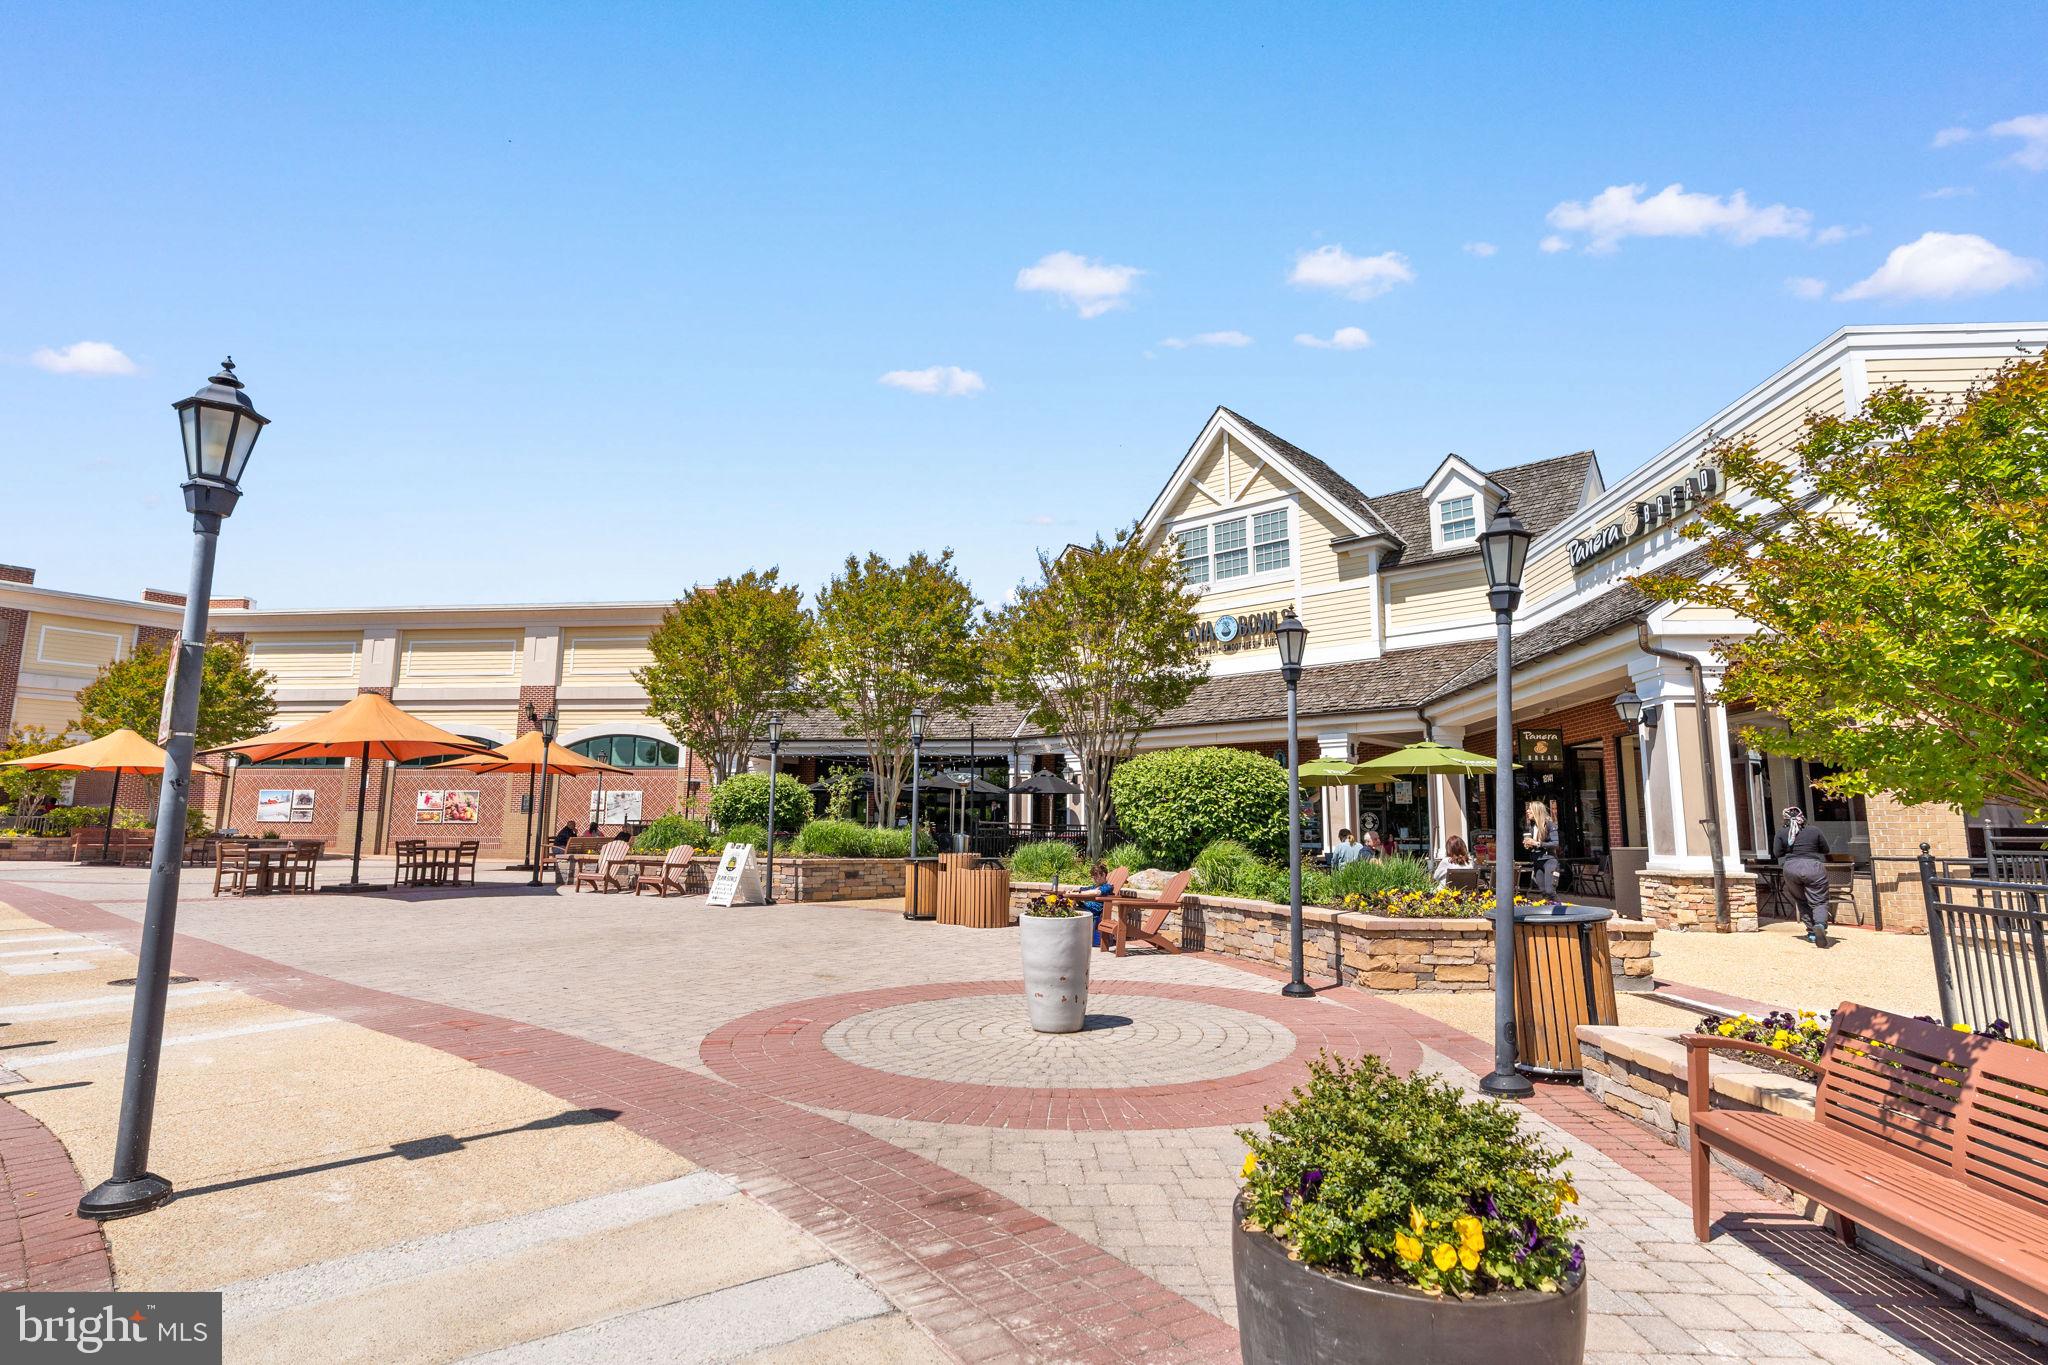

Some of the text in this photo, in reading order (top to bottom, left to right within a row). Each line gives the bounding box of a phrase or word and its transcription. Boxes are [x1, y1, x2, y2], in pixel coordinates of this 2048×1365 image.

[1566, 468, 1716, 568] Panera BREAD
[1187, 620, 1216, 643] AYA
[1522, 731, 1558, 740] Panera
